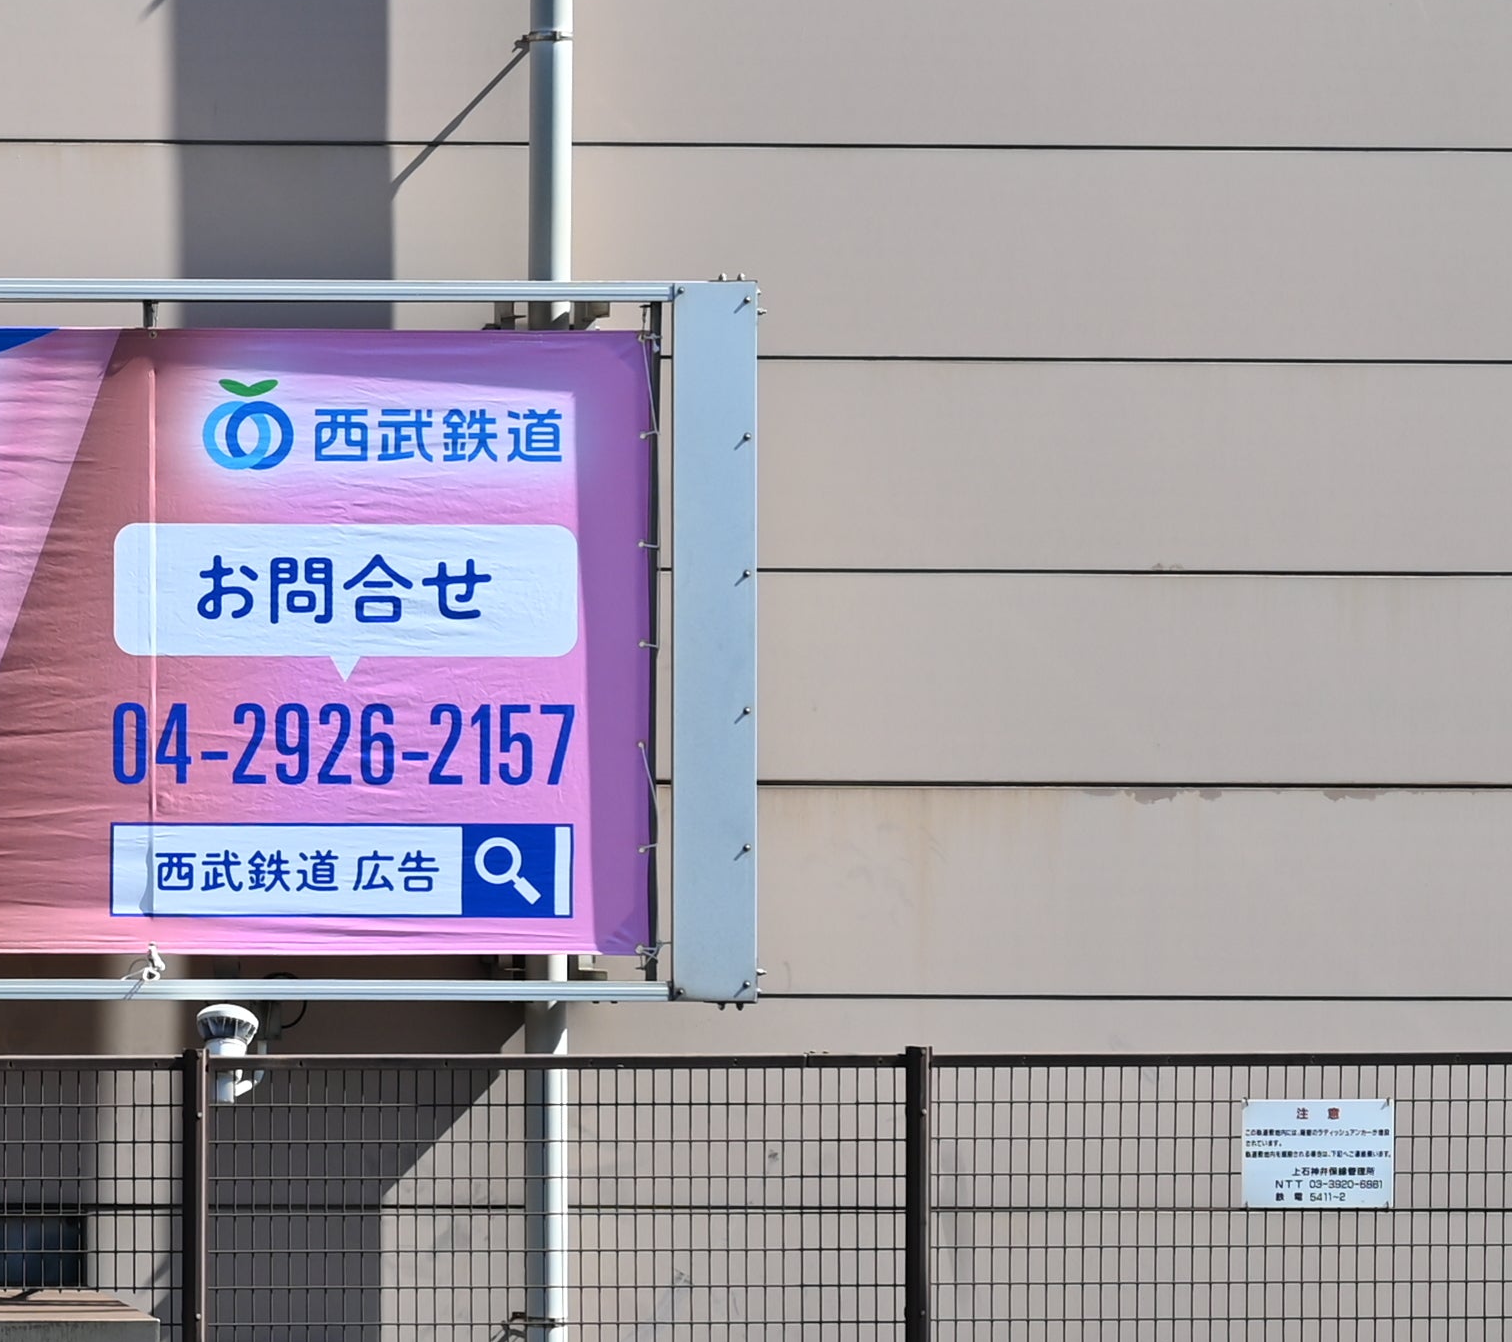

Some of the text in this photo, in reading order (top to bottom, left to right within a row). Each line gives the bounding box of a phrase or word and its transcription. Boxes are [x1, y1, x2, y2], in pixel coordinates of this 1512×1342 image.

[313, 408, 564, 463] 西武鉄道
[196, 554, 493, 625] お問合せ
[111, 702, 576, 786] 04-2926-2157
[154, 850, 441, 894] 西武鉄道 広告
[1275, 1179, 1304, 1189] NTT
